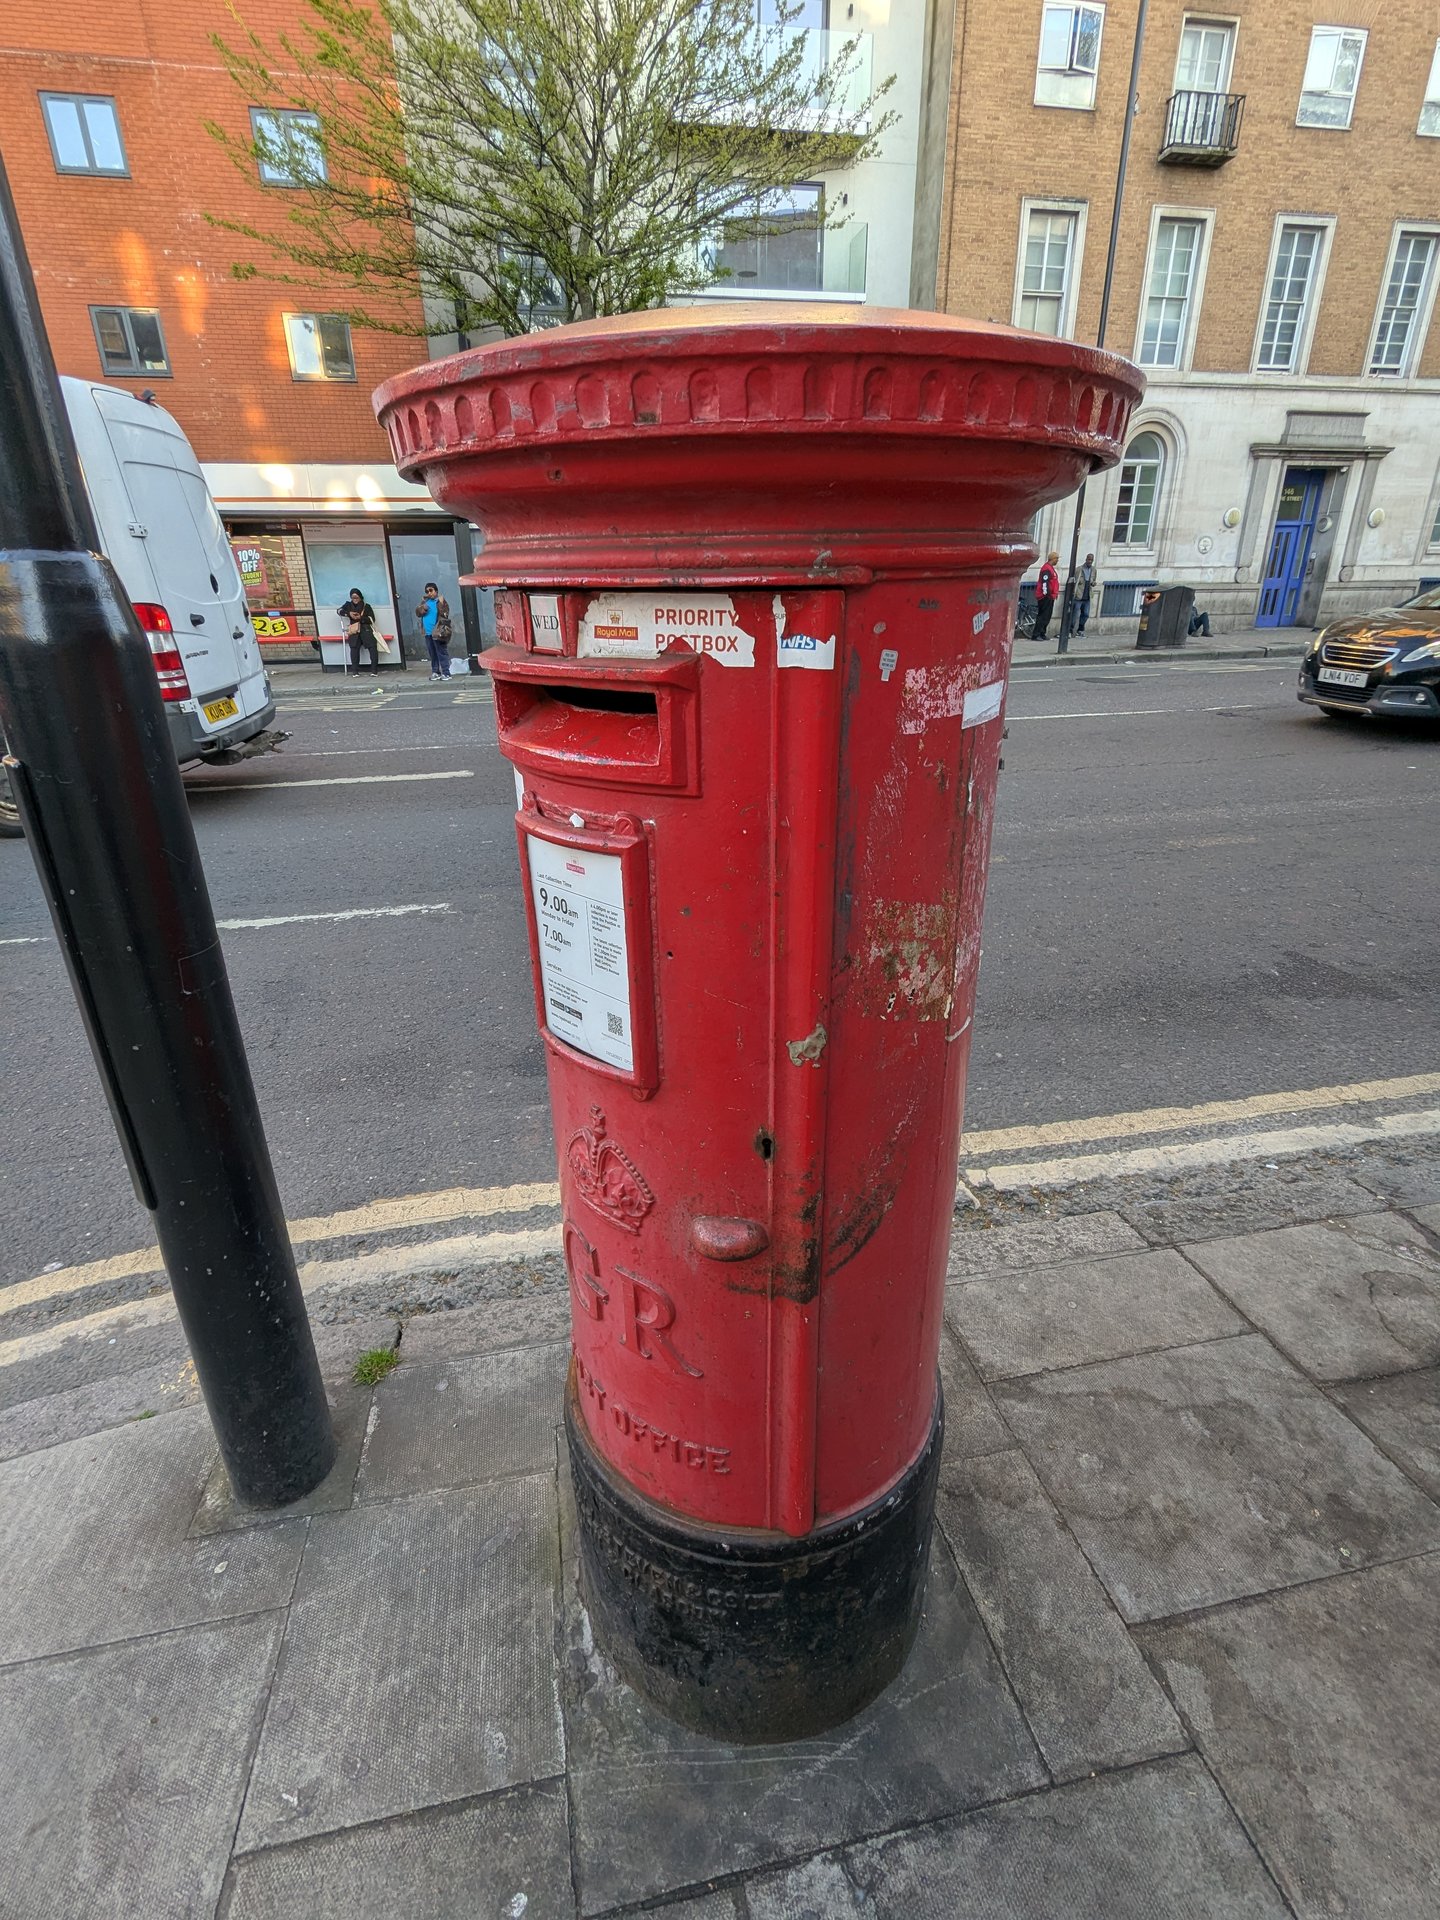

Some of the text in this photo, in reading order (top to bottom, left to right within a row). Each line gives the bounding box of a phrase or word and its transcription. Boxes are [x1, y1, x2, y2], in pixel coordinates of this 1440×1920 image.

[237, 548, 260, 562] 10%
[242, 560, 258, 572] OFF
[241, 571, 262, 580] STUDENT
[532, 614, 559, 630] WED
[654, 608, 739, 627] PRIORITY
[272, 622, 287, 633] £3
[596, 628, 636, 638] Royal Mail
[656, 634, 738, 652] POTBOX
[782, 634, 814, 648] NHS
[1323, 670, 1341, 681] LN14
[208, 702, 225, 720] KU16
[540, 887, 579, 919] 9.00am
[561, 918, 574, 928] Friday
[543, 924, 572, 947] 7.00am
[546, 961, 562, 972] Services
[612, 1403, 731, 1474] OFFICE
